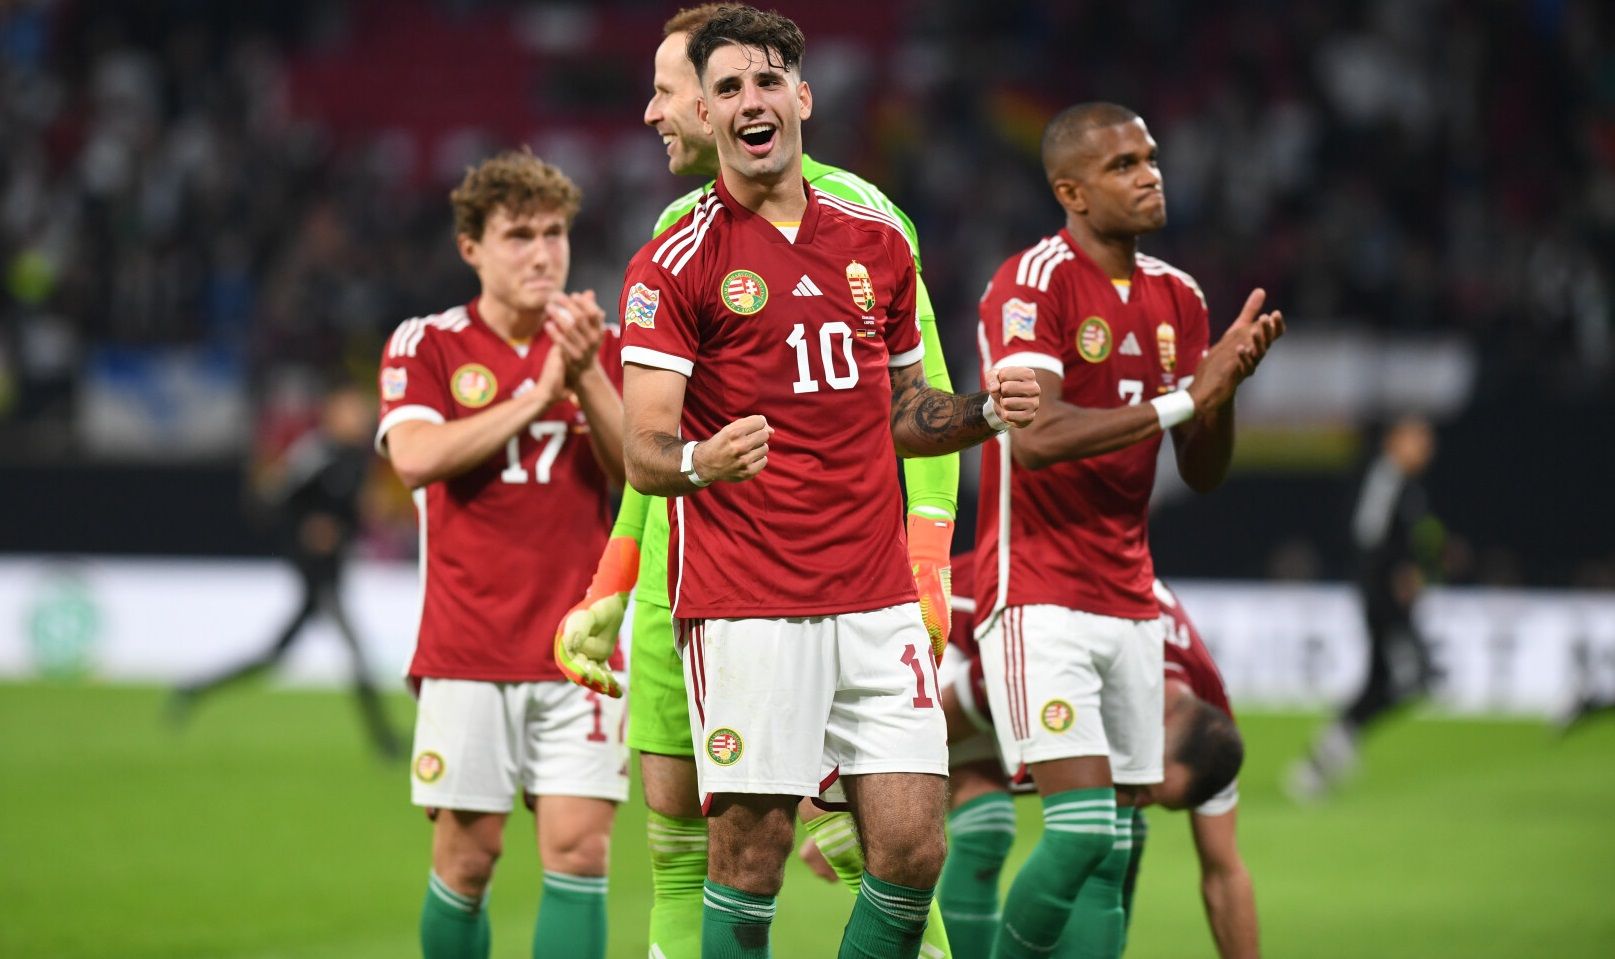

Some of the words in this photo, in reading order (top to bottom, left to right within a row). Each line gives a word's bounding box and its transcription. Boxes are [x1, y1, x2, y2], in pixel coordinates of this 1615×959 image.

[785, 321, 859, 394] 10
[501, 421, 567, 484] 17
[585, 691, 627, 743] 1
